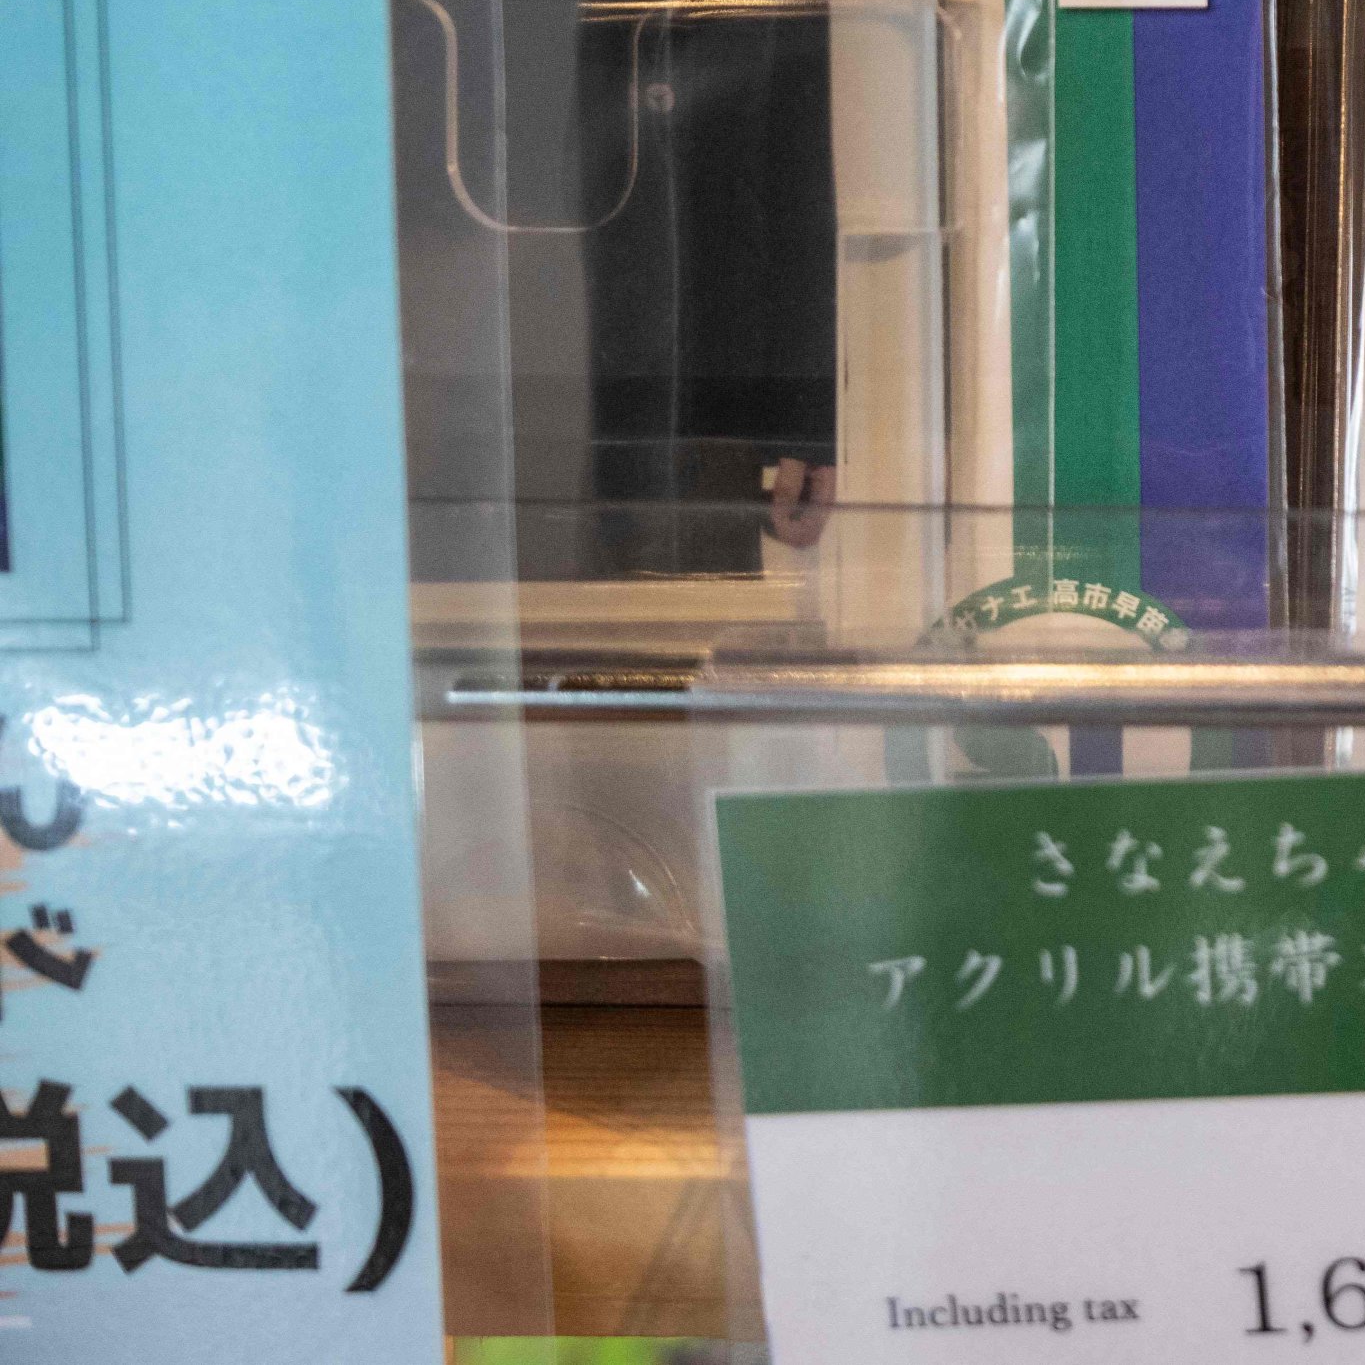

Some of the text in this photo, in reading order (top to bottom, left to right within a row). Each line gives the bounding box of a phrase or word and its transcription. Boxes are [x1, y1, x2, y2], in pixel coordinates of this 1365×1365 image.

[1053, 579, 1171, 635] 高市早苗
[886, 1293, 1141, 1333] Including tax
